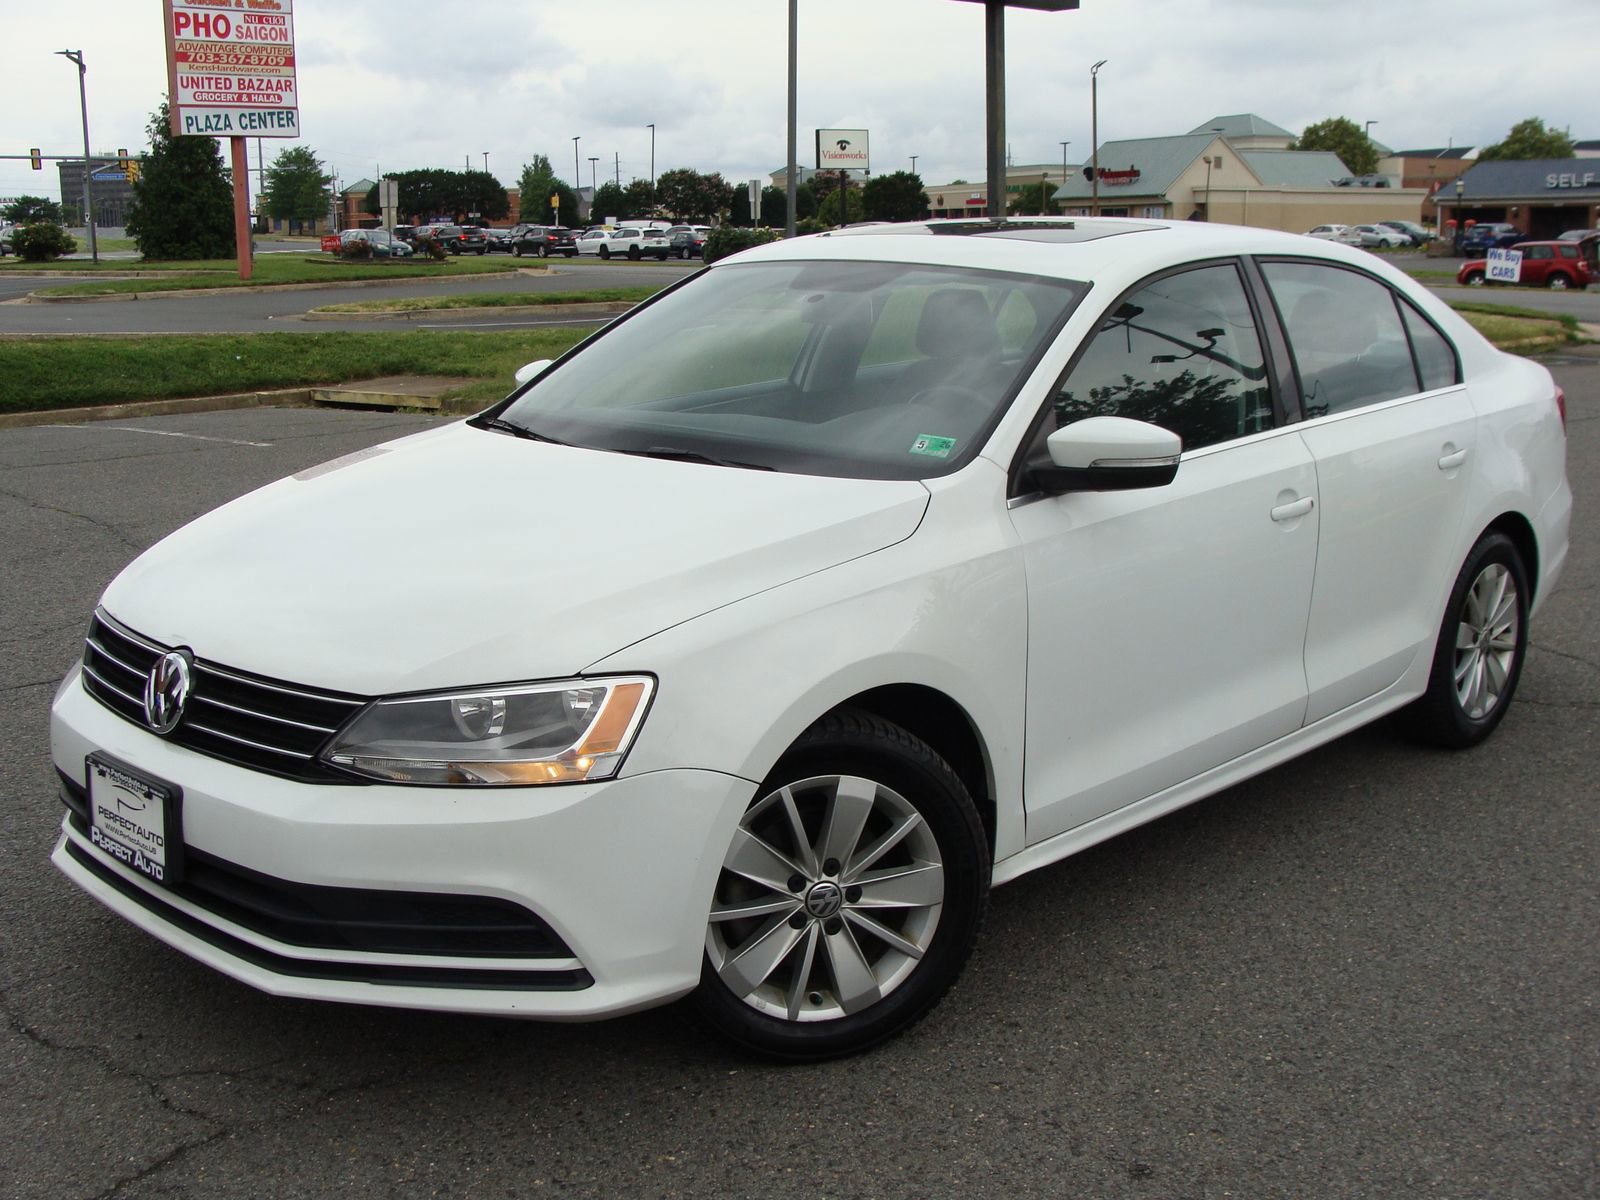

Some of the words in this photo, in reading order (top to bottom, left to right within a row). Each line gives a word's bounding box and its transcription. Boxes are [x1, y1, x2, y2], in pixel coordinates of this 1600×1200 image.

[174, 11, 231, 39] PHO
[235, 24, 288, 42] SAIGON
[177, 42, 237, 54] ADVANTAGE
[239, 45, 293, 56] COMPUTERS
[187, 52, 286, 66] 703-367-8709
[188, 63, 281, 74] KensHardware.com
[180, 76, 233, 90] UNITED
[237, 78, 293, 92] BAZAAR
[195, 92, 239, 102] GROCERY
[242, 93, 248, 102] &
[251, 94, 281, 103] HALAL
[185, 113, 233, 133] PLAZA
[239, 111, 296, 130] CENTER
[822, 150, 867, 160] Visionworks
[1545, 172, 1595, 188] SELF
[1488, 249, 1503, 261] We
[1504, 250, 1521, 264] Buy
[1491, 266, 1516, 278] CARS
[917, 440, 926, 449] 5
